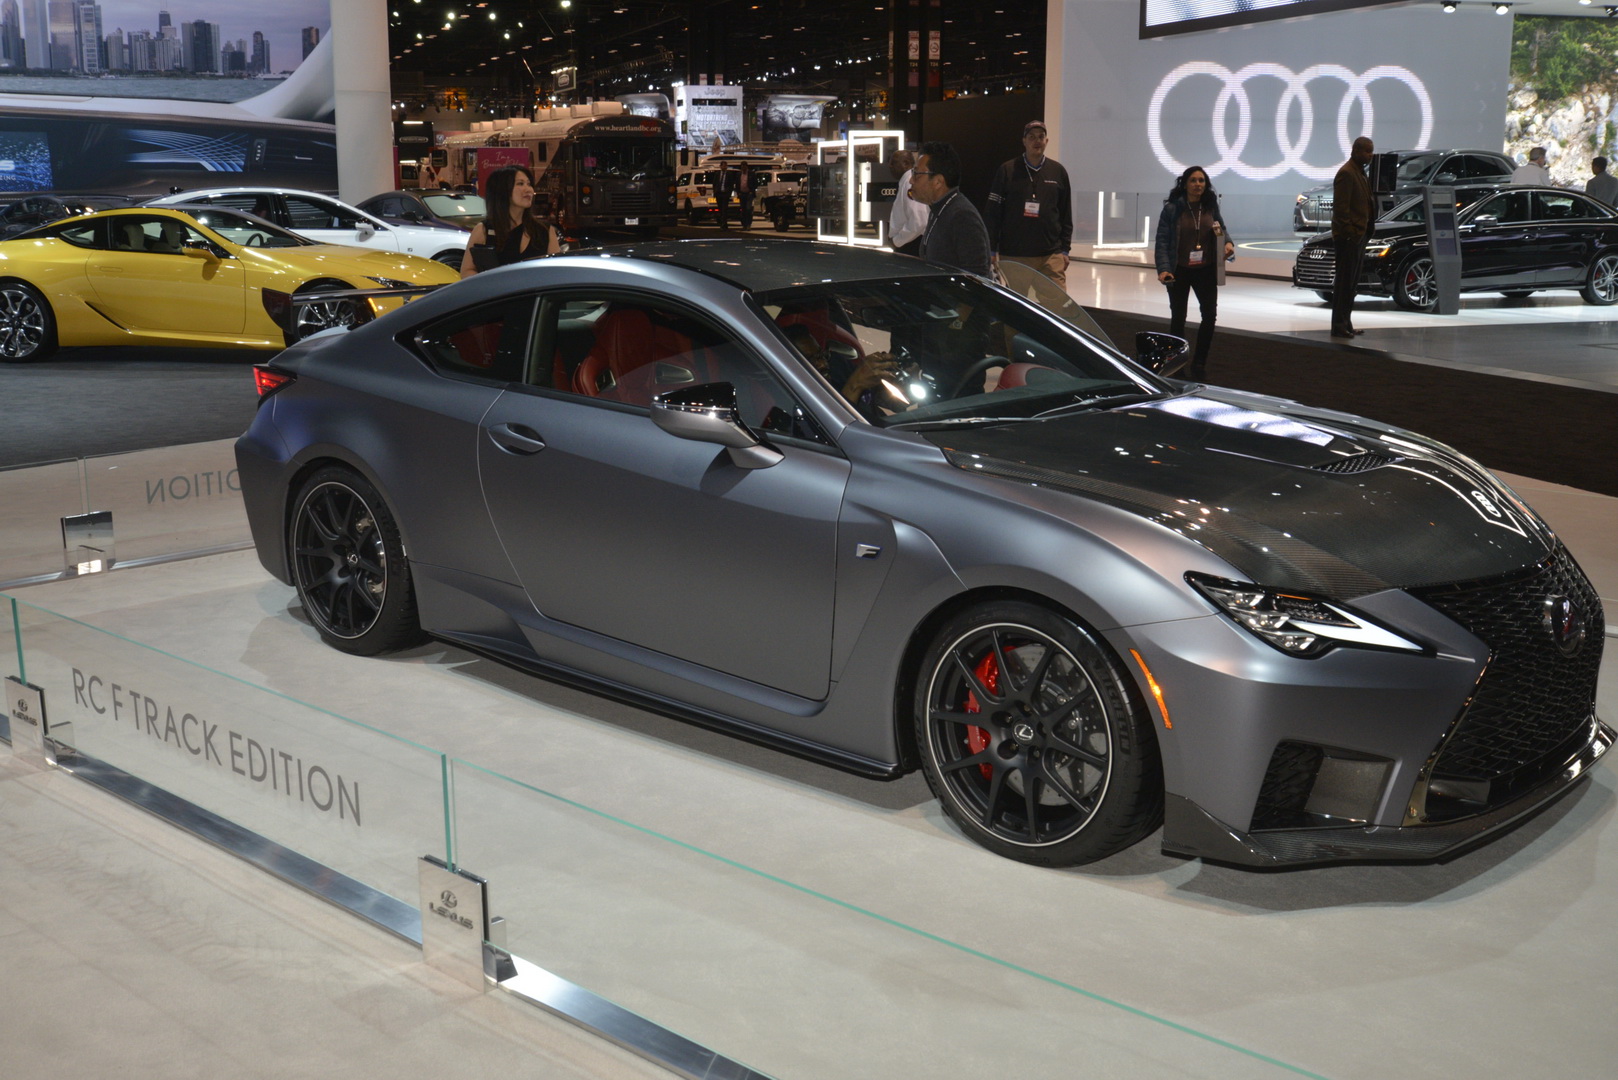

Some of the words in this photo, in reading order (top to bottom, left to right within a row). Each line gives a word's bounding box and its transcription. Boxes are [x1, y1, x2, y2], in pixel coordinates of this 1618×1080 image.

[704, 87, 726, 97] Jeep
[594, 124, 662, 133] www.heartlandbc.org
[12, 708, 38, 727] LEXUS
[72, 667, 107, 715] RC
[112, 683, 124, 721] F
[129, 690, 222, 767] TRACK
[229, 730, 362, 827] EDITION
[428, 901, 474, 930] LEXUS
